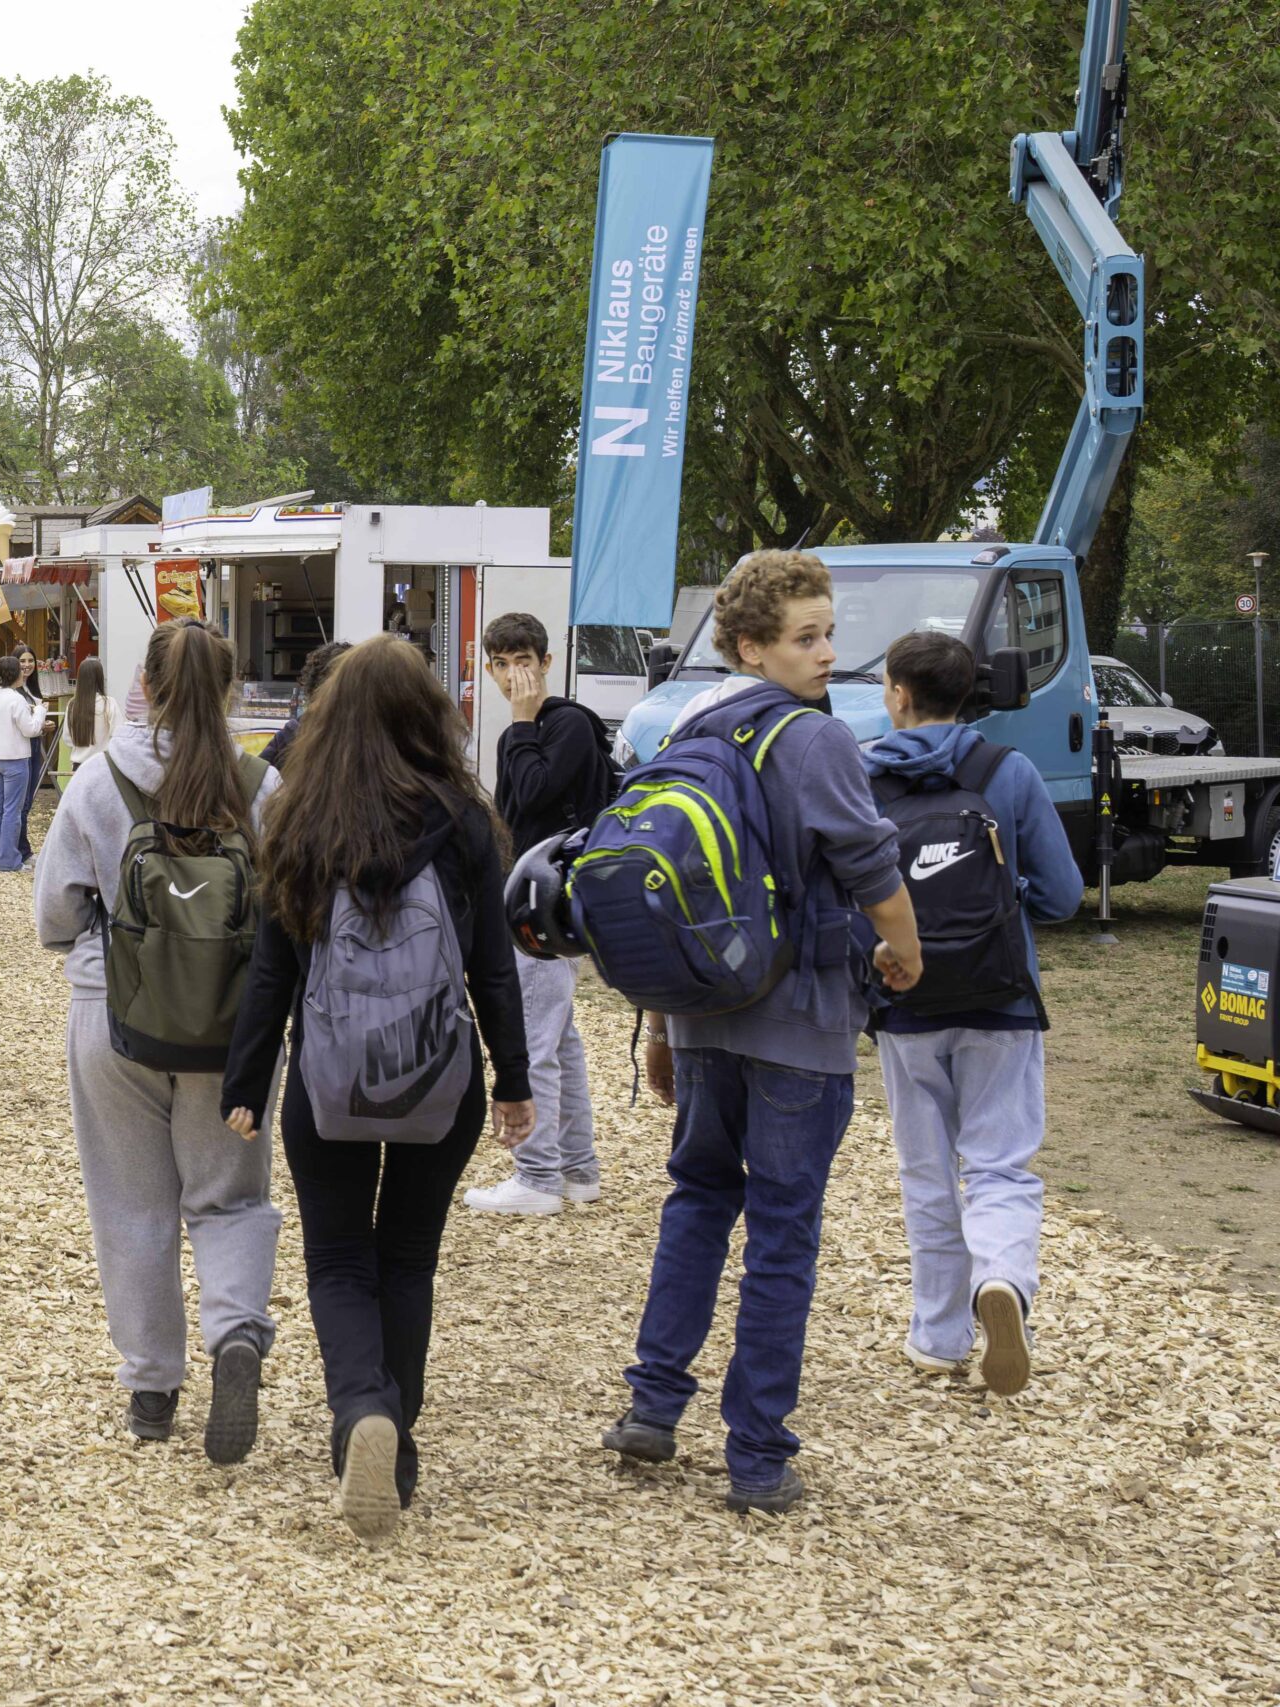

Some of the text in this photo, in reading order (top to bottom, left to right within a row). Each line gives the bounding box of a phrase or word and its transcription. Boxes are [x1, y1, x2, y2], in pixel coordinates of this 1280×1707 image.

[597, 259, 634, 383] Niklaus
[629, 225, 669, 384] Baugeräte
[662, 227, 699, 457] Wir helfen Heimat bauen
[591, 405, 649, 457] N
[1240, 599, 1251, 608] 30
[918, 841, 961, 865] NIKE
[365, 984, 457, 1089] NIKE
[1220, 990, 1265, 1020] BOMAG
